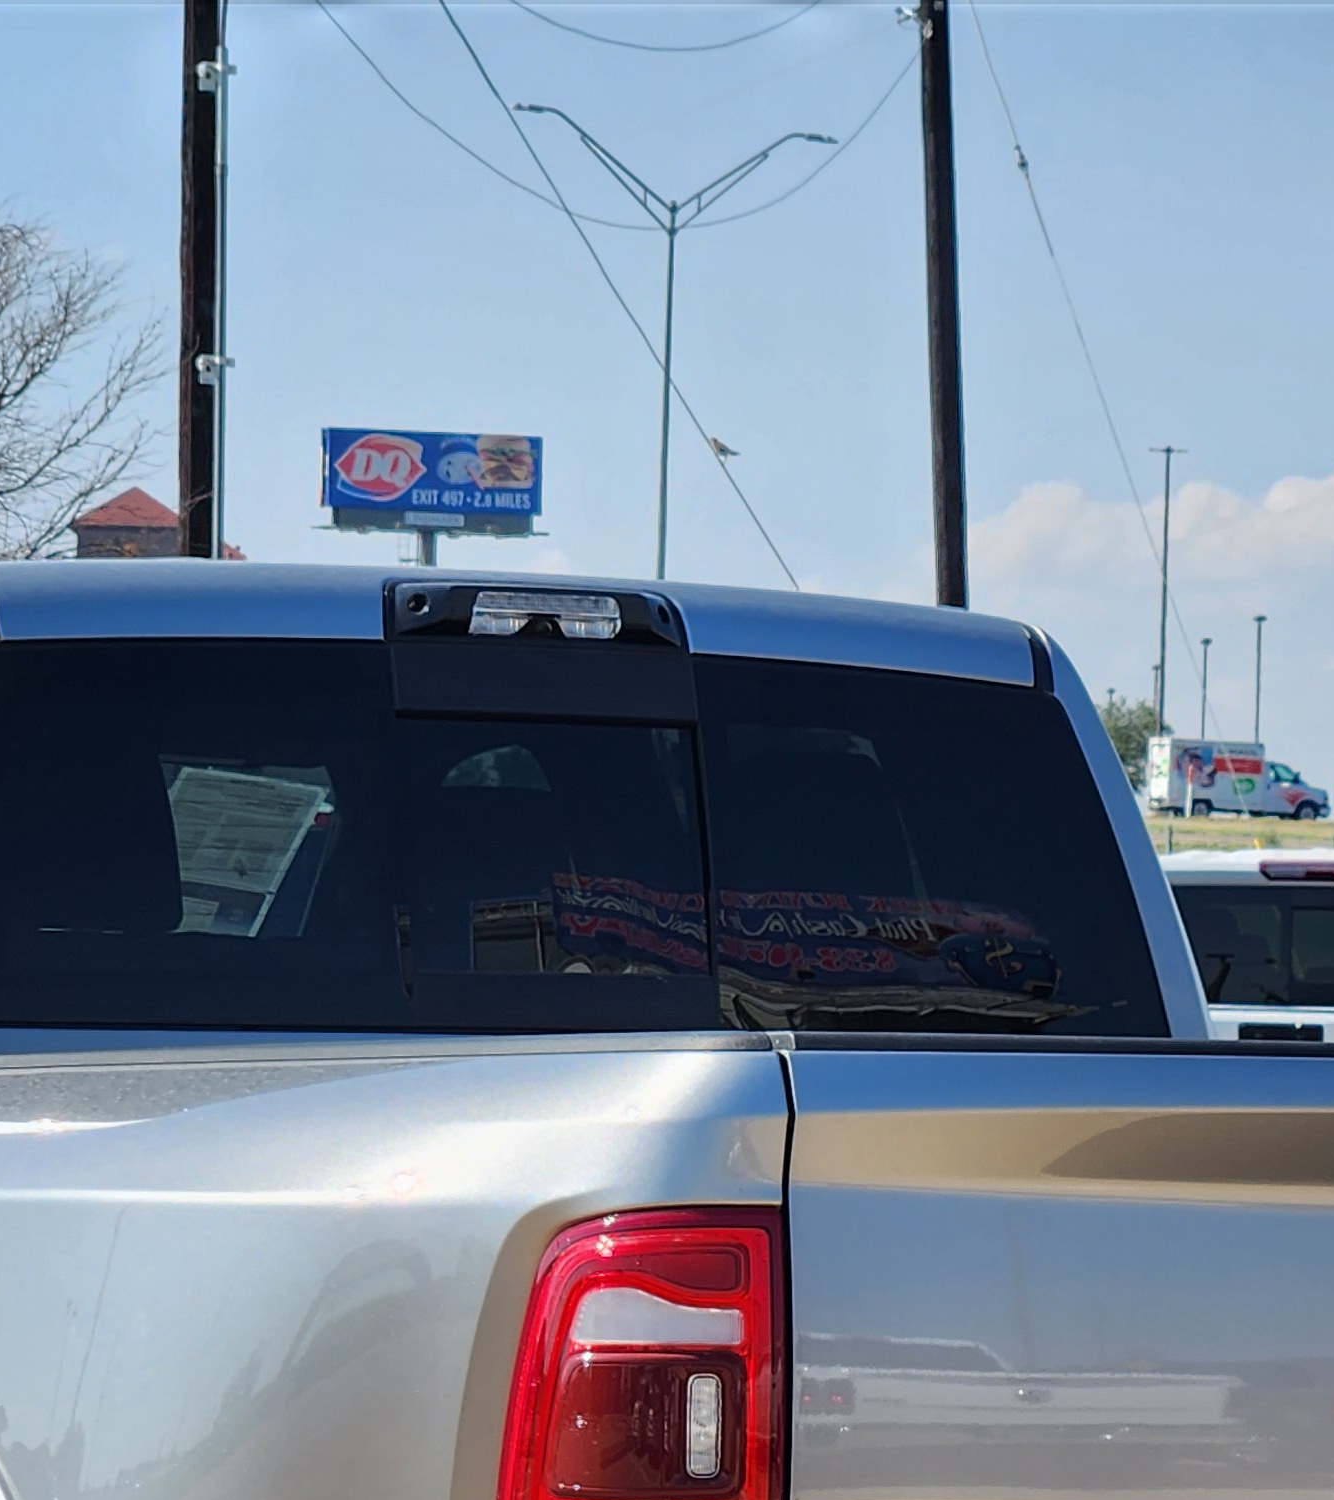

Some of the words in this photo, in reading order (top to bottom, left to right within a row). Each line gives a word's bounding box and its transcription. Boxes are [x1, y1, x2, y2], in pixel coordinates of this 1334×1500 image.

[352, 448, 411, 490] DQ
[412, 489, 439, 505] EXIT
[441, 490, 464, 507] 497
[495, 492, 531, 509] MILES
